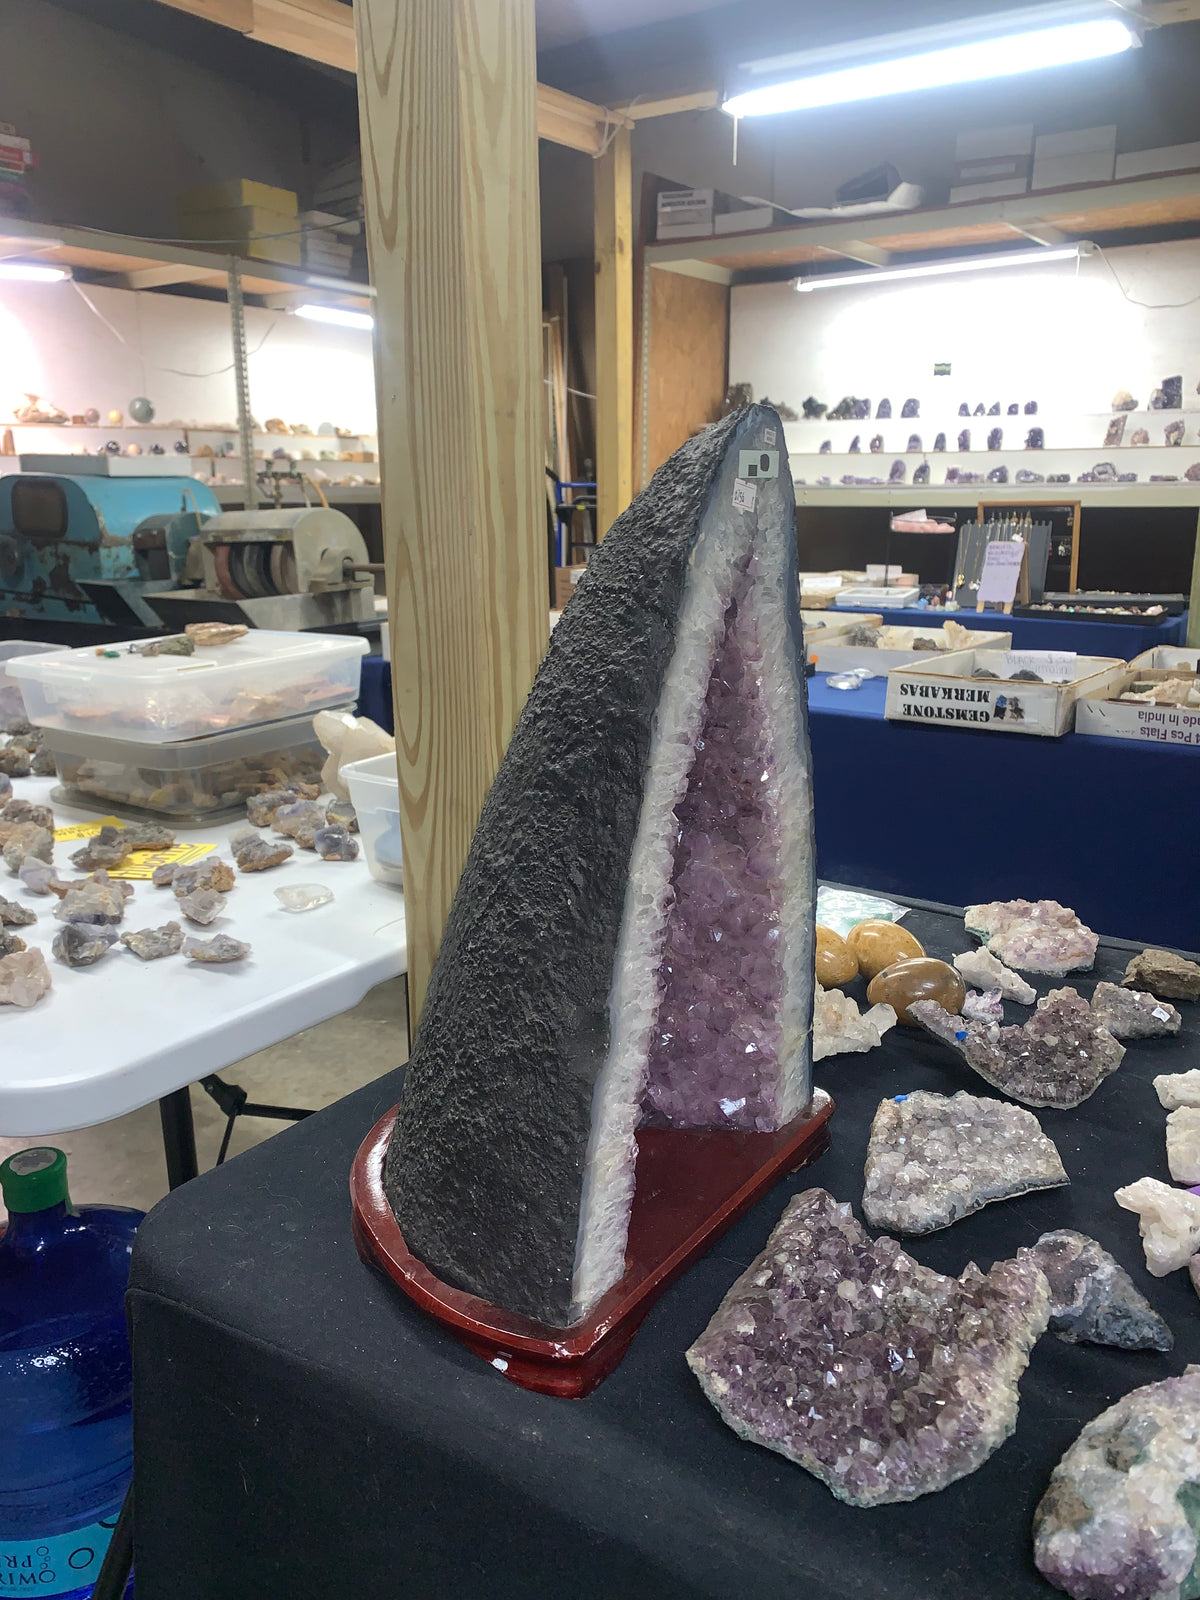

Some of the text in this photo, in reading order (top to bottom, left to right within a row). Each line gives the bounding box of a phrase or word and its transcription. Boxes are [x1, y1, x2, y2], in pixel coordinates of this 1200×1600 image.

[900, 683, 991, 703] MERKABAS
[902, 703, 990, 723] GEMSTONE
[1138, 710, 1165, 724] India
[1168, 714, 1179, 726] In
[1140, 726, 1167, 740] Flats
[1171, 730, 1192, 744] Pcs
